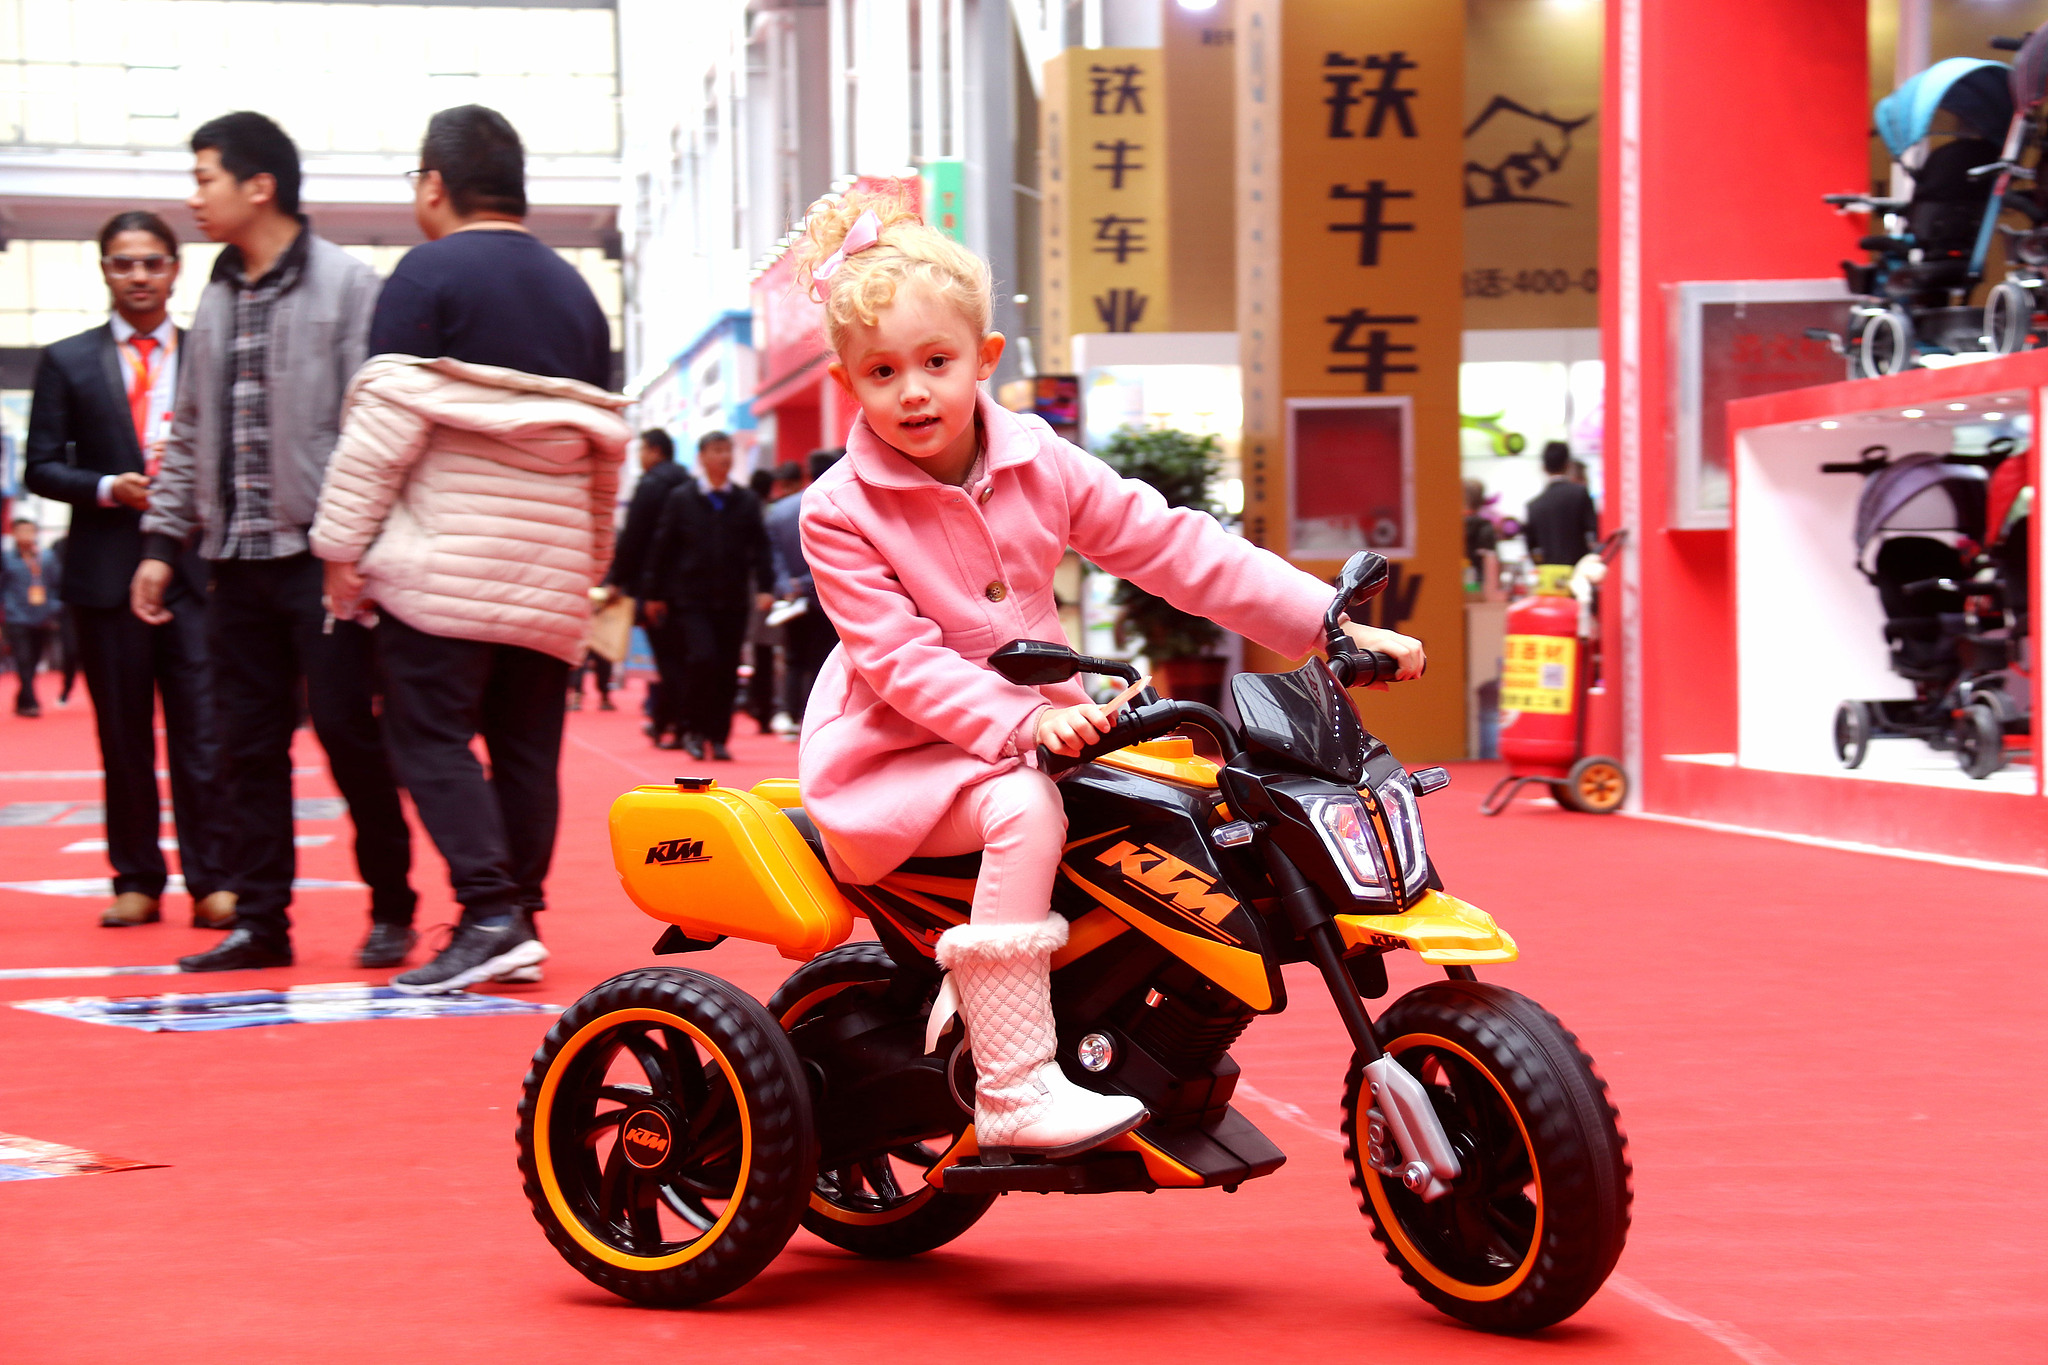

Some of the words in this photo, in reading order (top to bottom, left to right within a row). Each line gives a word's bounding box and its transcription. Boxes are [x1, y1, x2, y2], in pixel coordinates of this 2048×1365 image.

[1089, 63, 1150, 333] 铁牛车业
[645, 837, 704, 864] KTM
[1094, 840, 1240, 925] KTM
[1370, 933, 1411, 950] KTM
[625, 1128, 668, 1152] KTM
